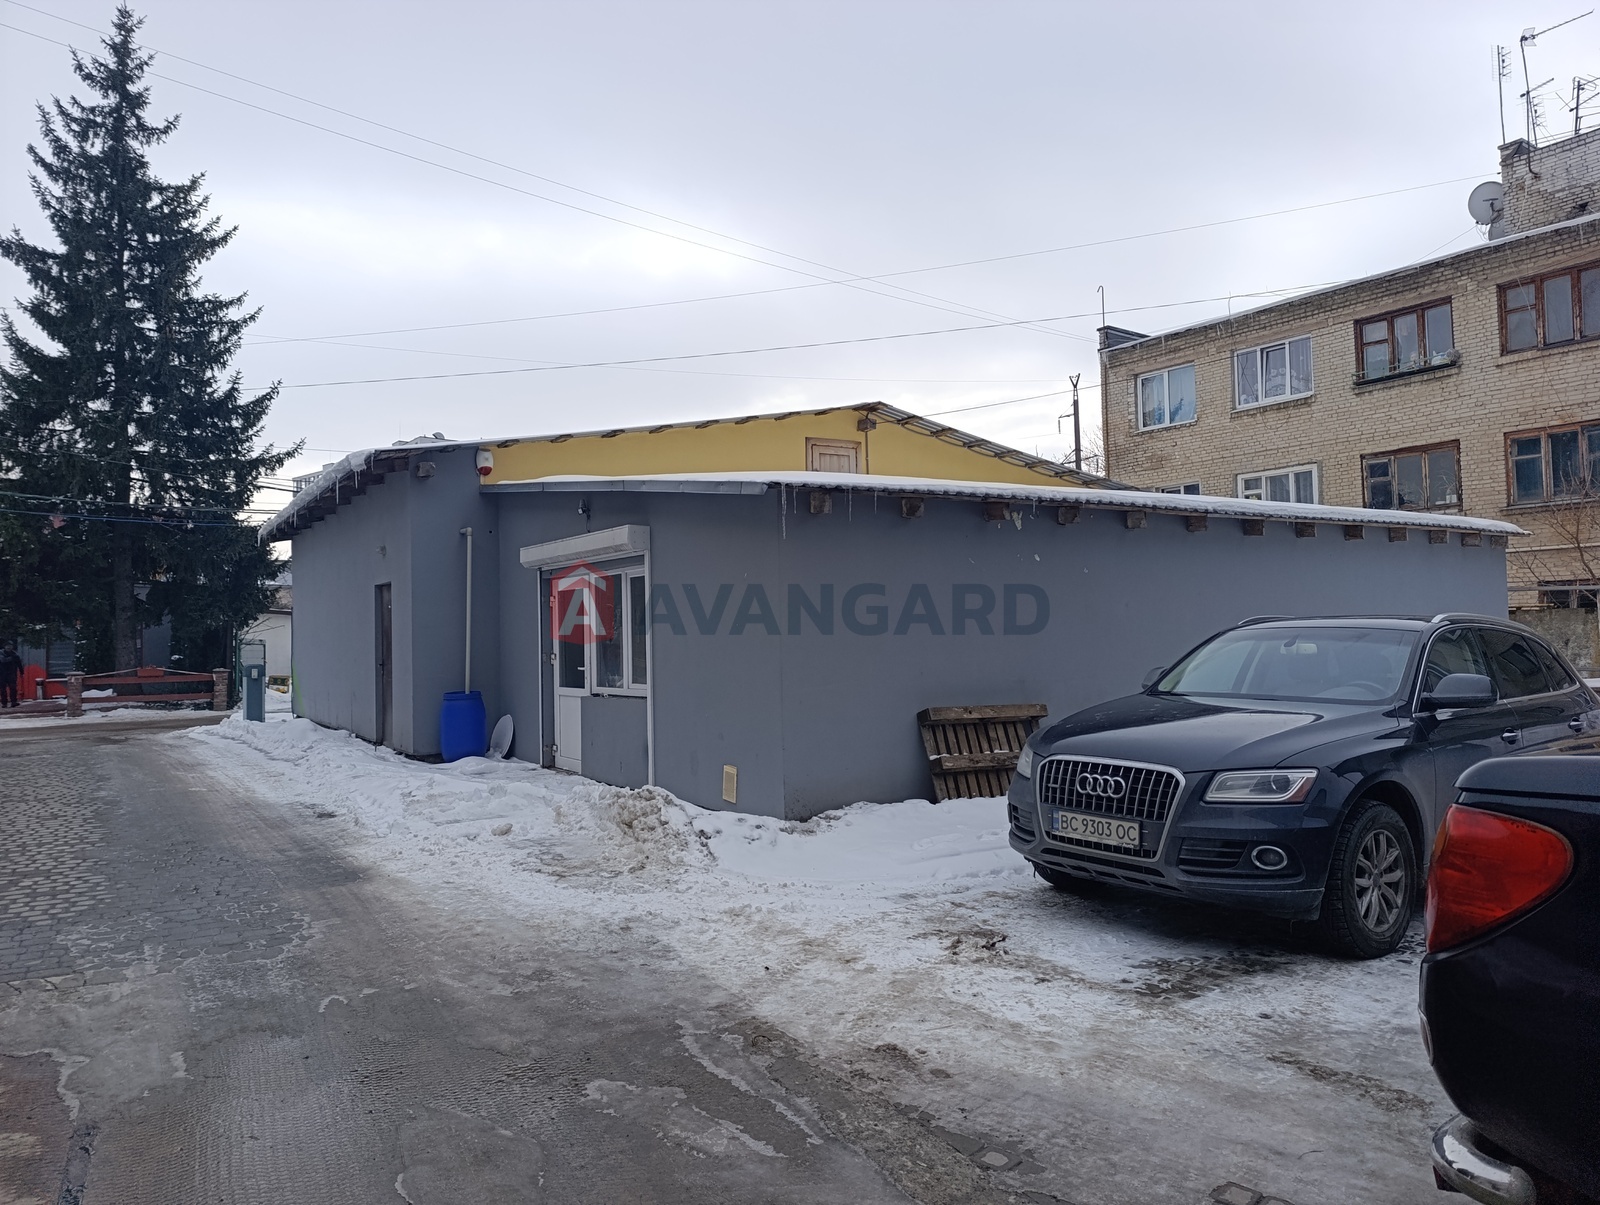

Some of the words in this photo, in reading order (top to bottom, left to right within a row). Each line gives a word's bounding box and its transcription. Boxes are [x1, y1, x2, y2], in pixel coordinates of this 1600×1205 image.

[1060, 814, 1079, 832] BC
[1081, 818, 1112, 837] 9303
[1115, 823, 1137, 842] OC
